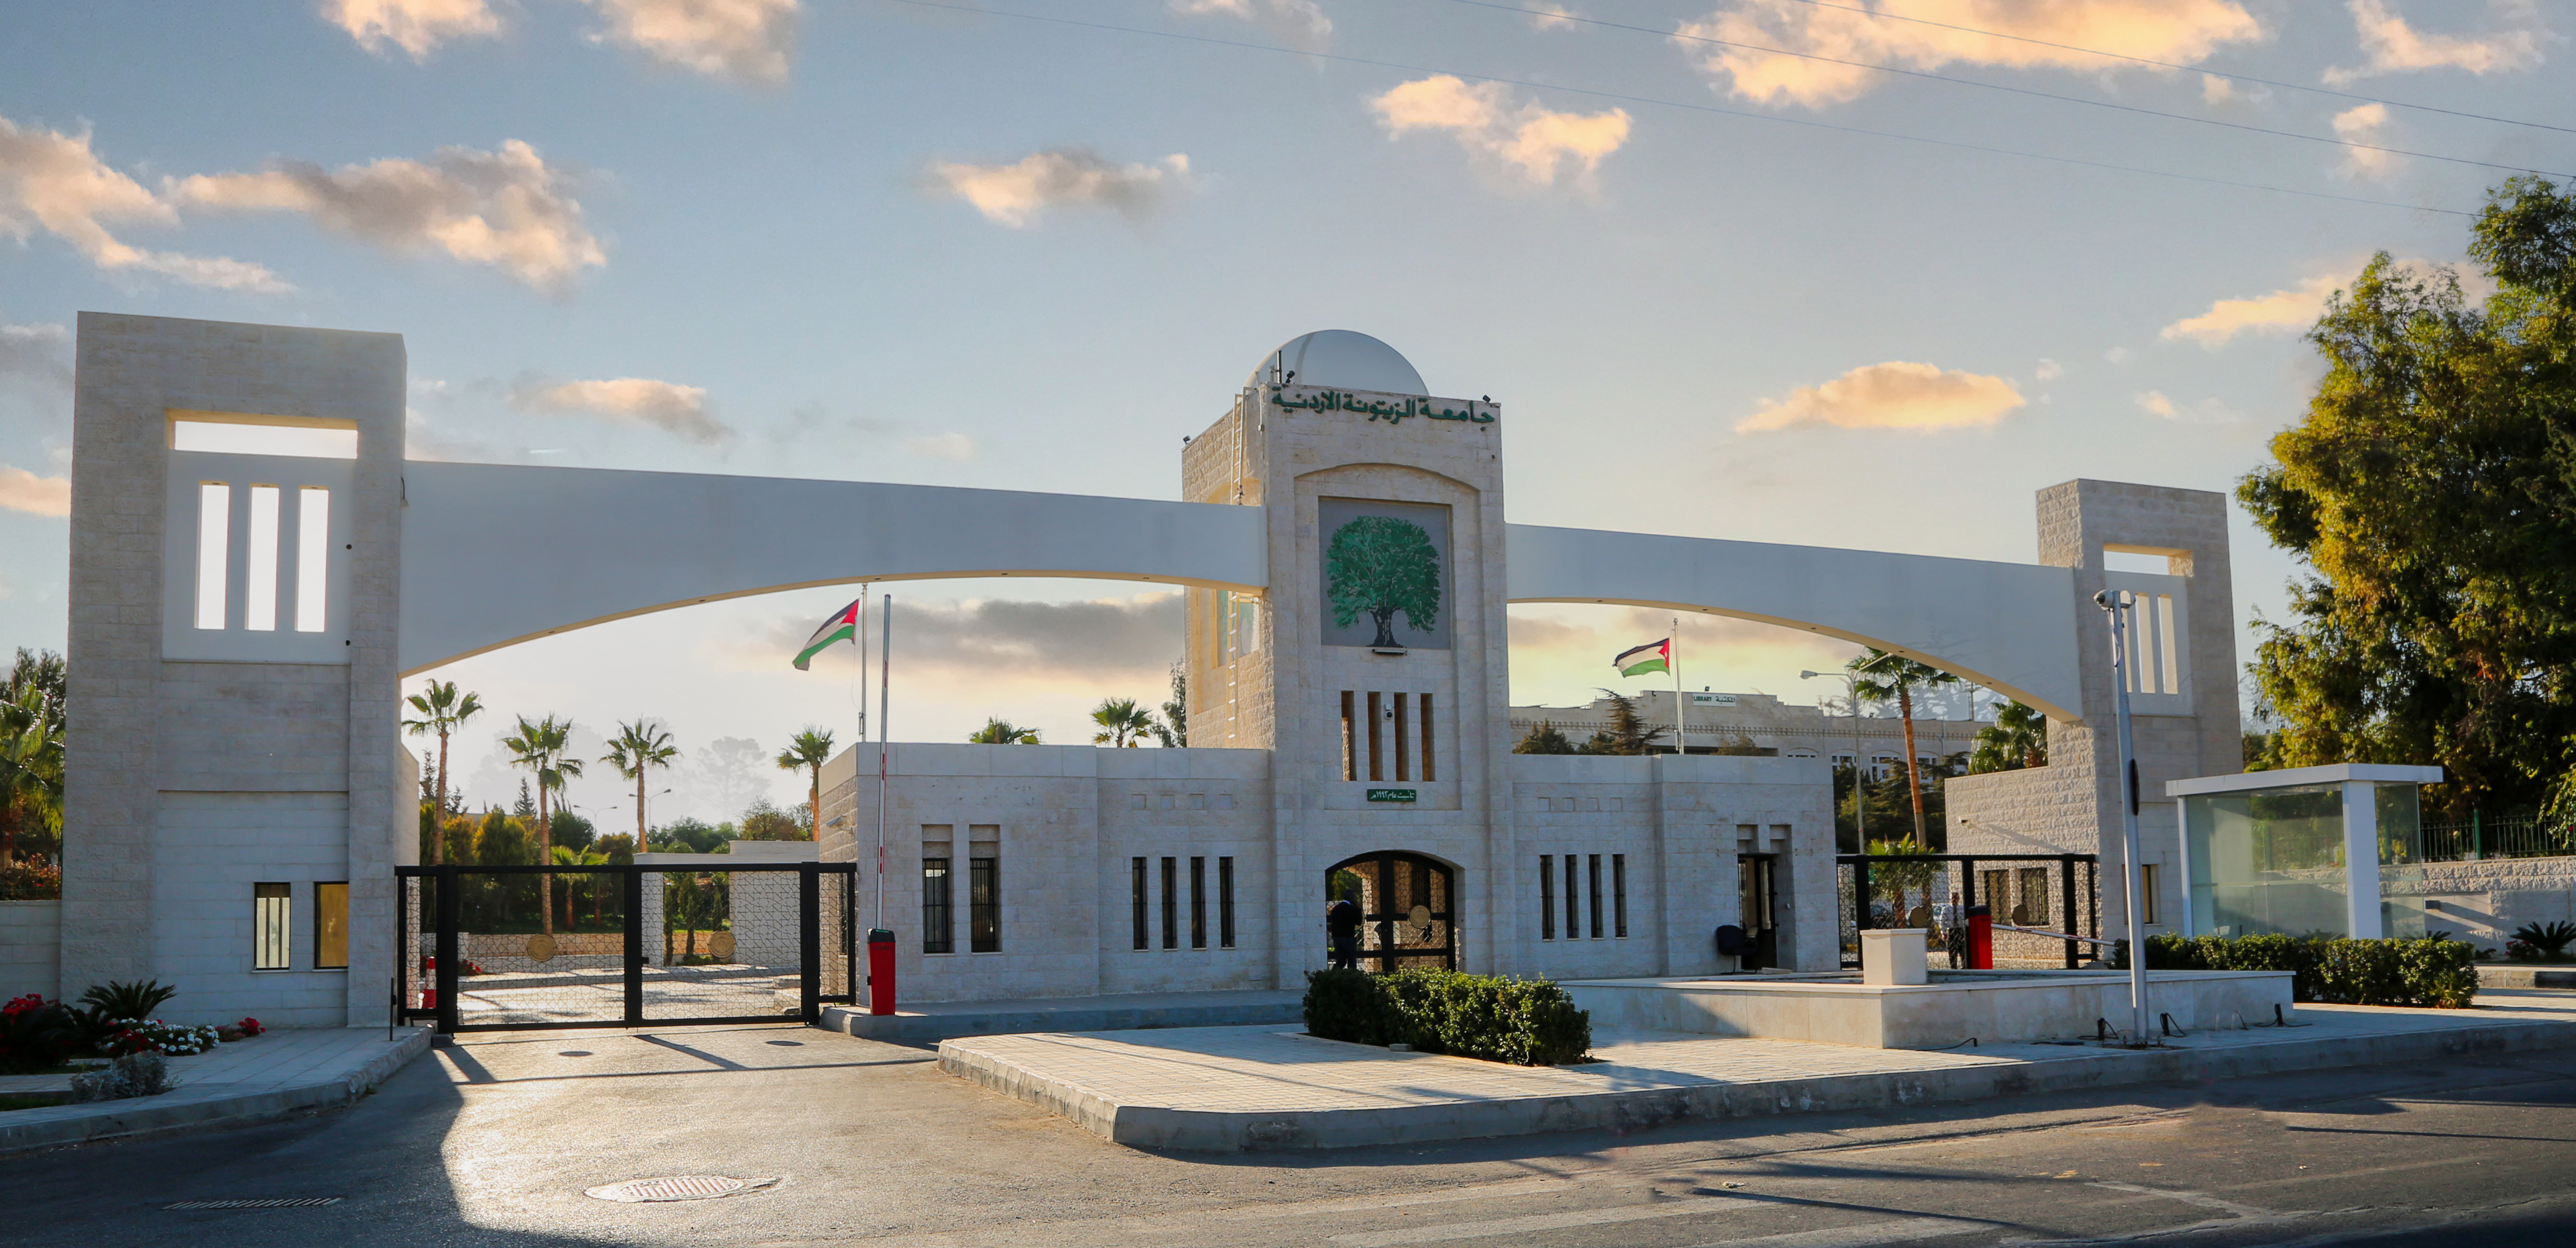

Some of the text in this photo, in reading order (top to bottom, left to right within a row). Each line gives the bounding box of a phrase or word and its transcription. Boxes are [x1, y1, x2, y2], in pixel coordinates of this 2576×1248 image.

[1343, 393, 1416, 424] الزيتونة
[1418, 398, 1495, 431] جامعة
[1715, 696, 1735, 705] المكتبة
